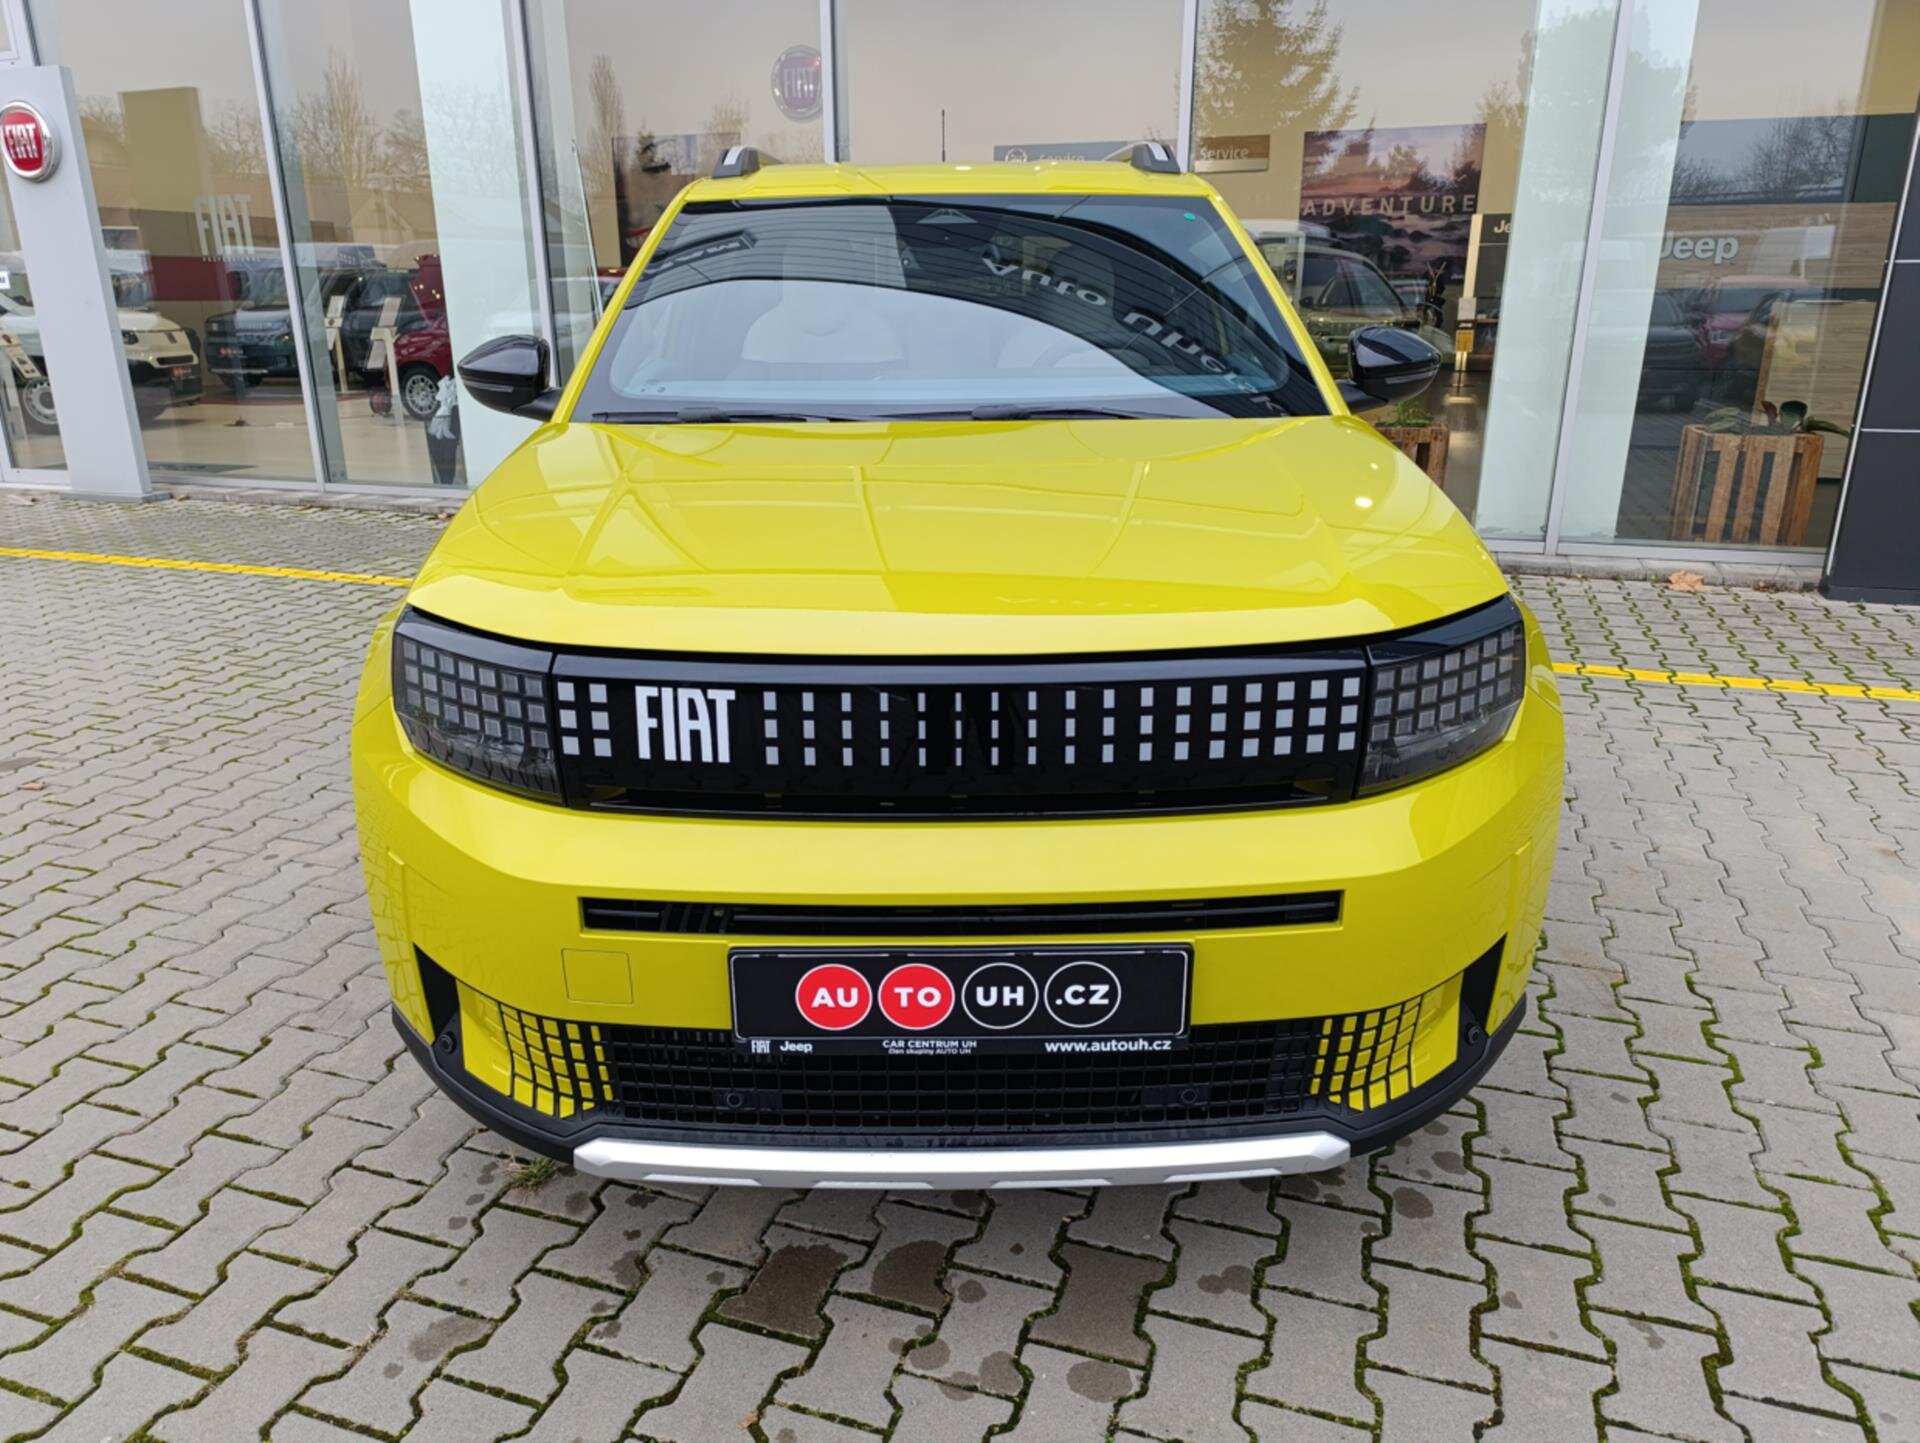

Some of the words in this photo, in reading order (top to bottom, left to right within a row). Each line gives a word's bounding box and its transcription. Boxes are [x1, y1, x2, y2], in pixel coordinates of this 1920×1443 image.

[4, 123, 39, 159] FIAT
[1200, 145, 1249, 160] Service
[1302, 194, 1476, 216] ADVENTURE
[192, 193, 255, 256] FIAT
[1661, 231, 1739, 264] Jeep
[635, 685, 735, 763] FIAT
[751, 1040, 770, 1054] FIAT
[780, 1041, 813, 1053] Jeep
[882, 1040, 905, 1048] CAR
[907, 1040, 959, 1048] CENTRUM
[961, 1040, 977, 1048] UH
[1045, 1038, 1172, 1052] www.autouh.cz
